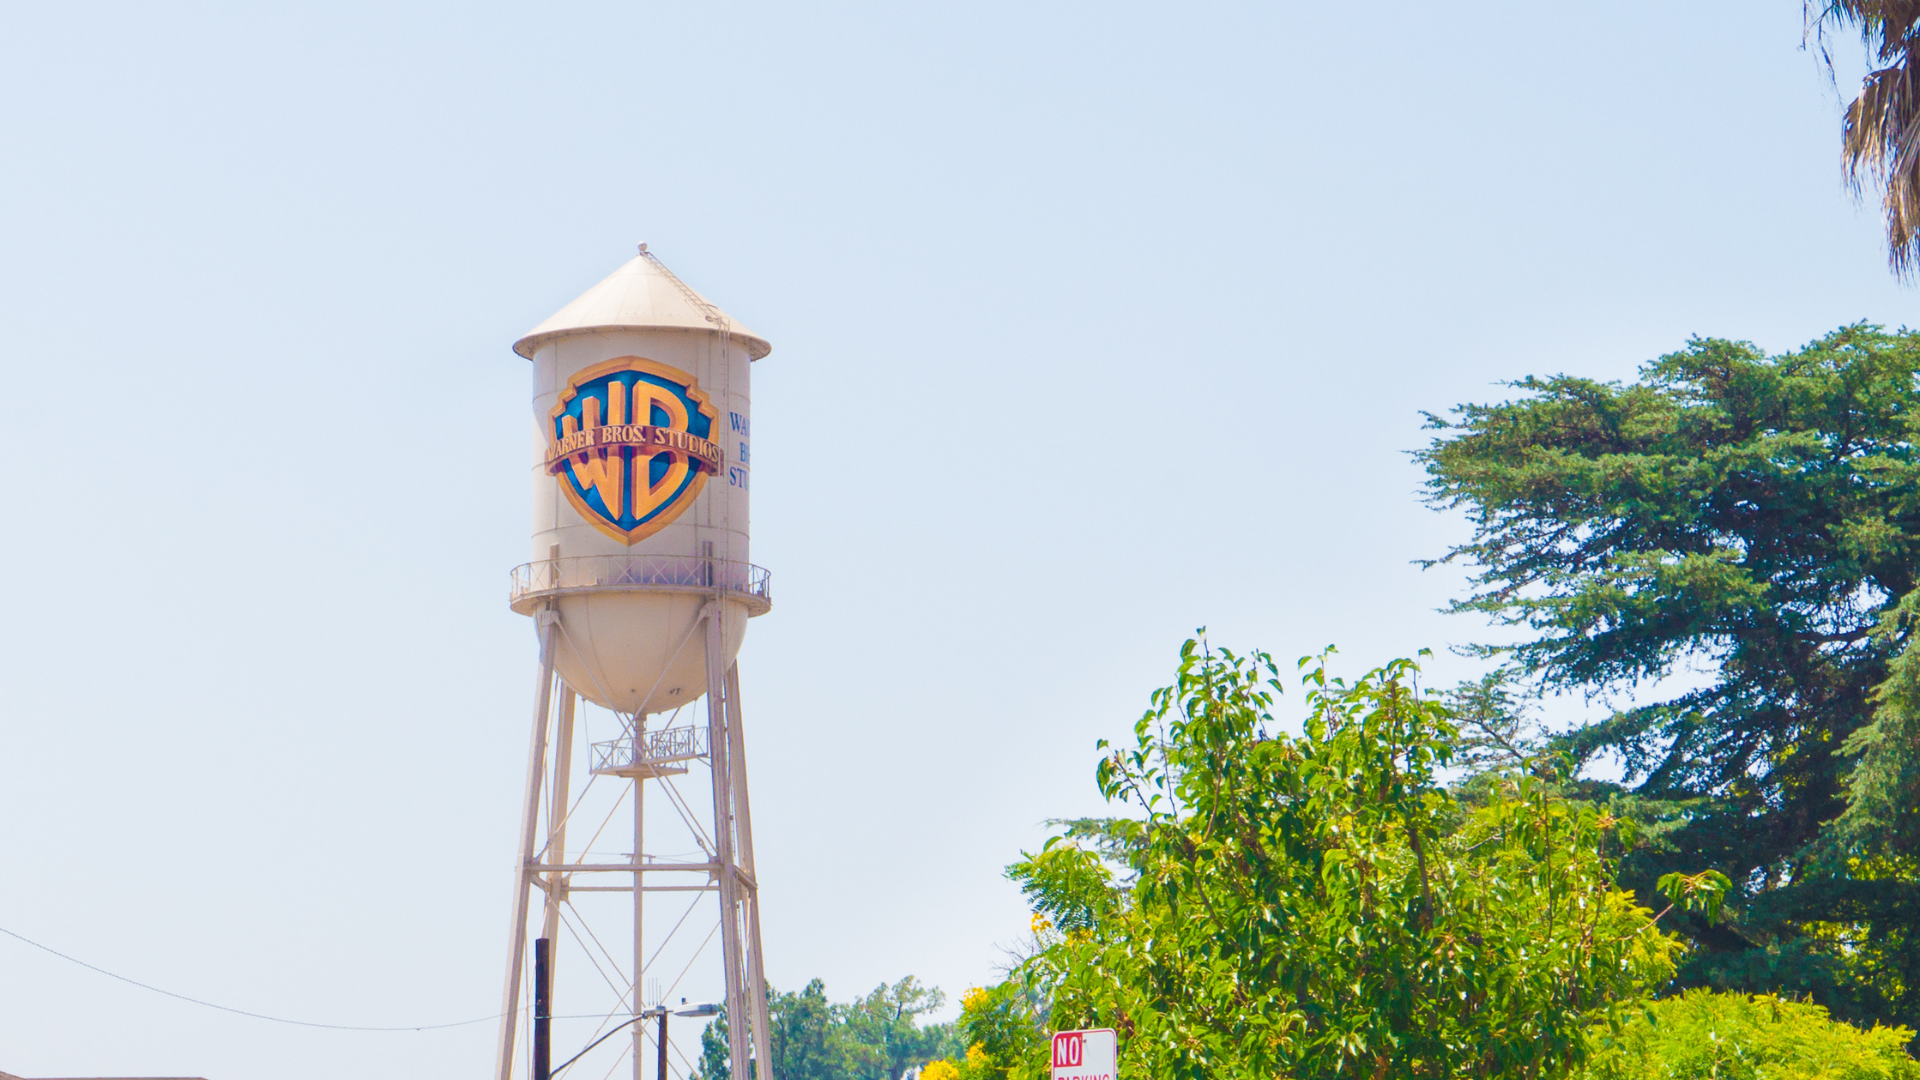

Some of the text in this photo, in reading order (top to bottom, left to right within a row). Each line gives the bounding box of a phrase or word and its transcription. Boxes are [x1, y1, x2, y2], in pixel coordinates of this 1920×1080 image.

[547, 425, 719, 463] WARNER BROS. STUDIOS
[561, 379, 690, 521] WB
[1057, 1036, 1080, 1065] NO
